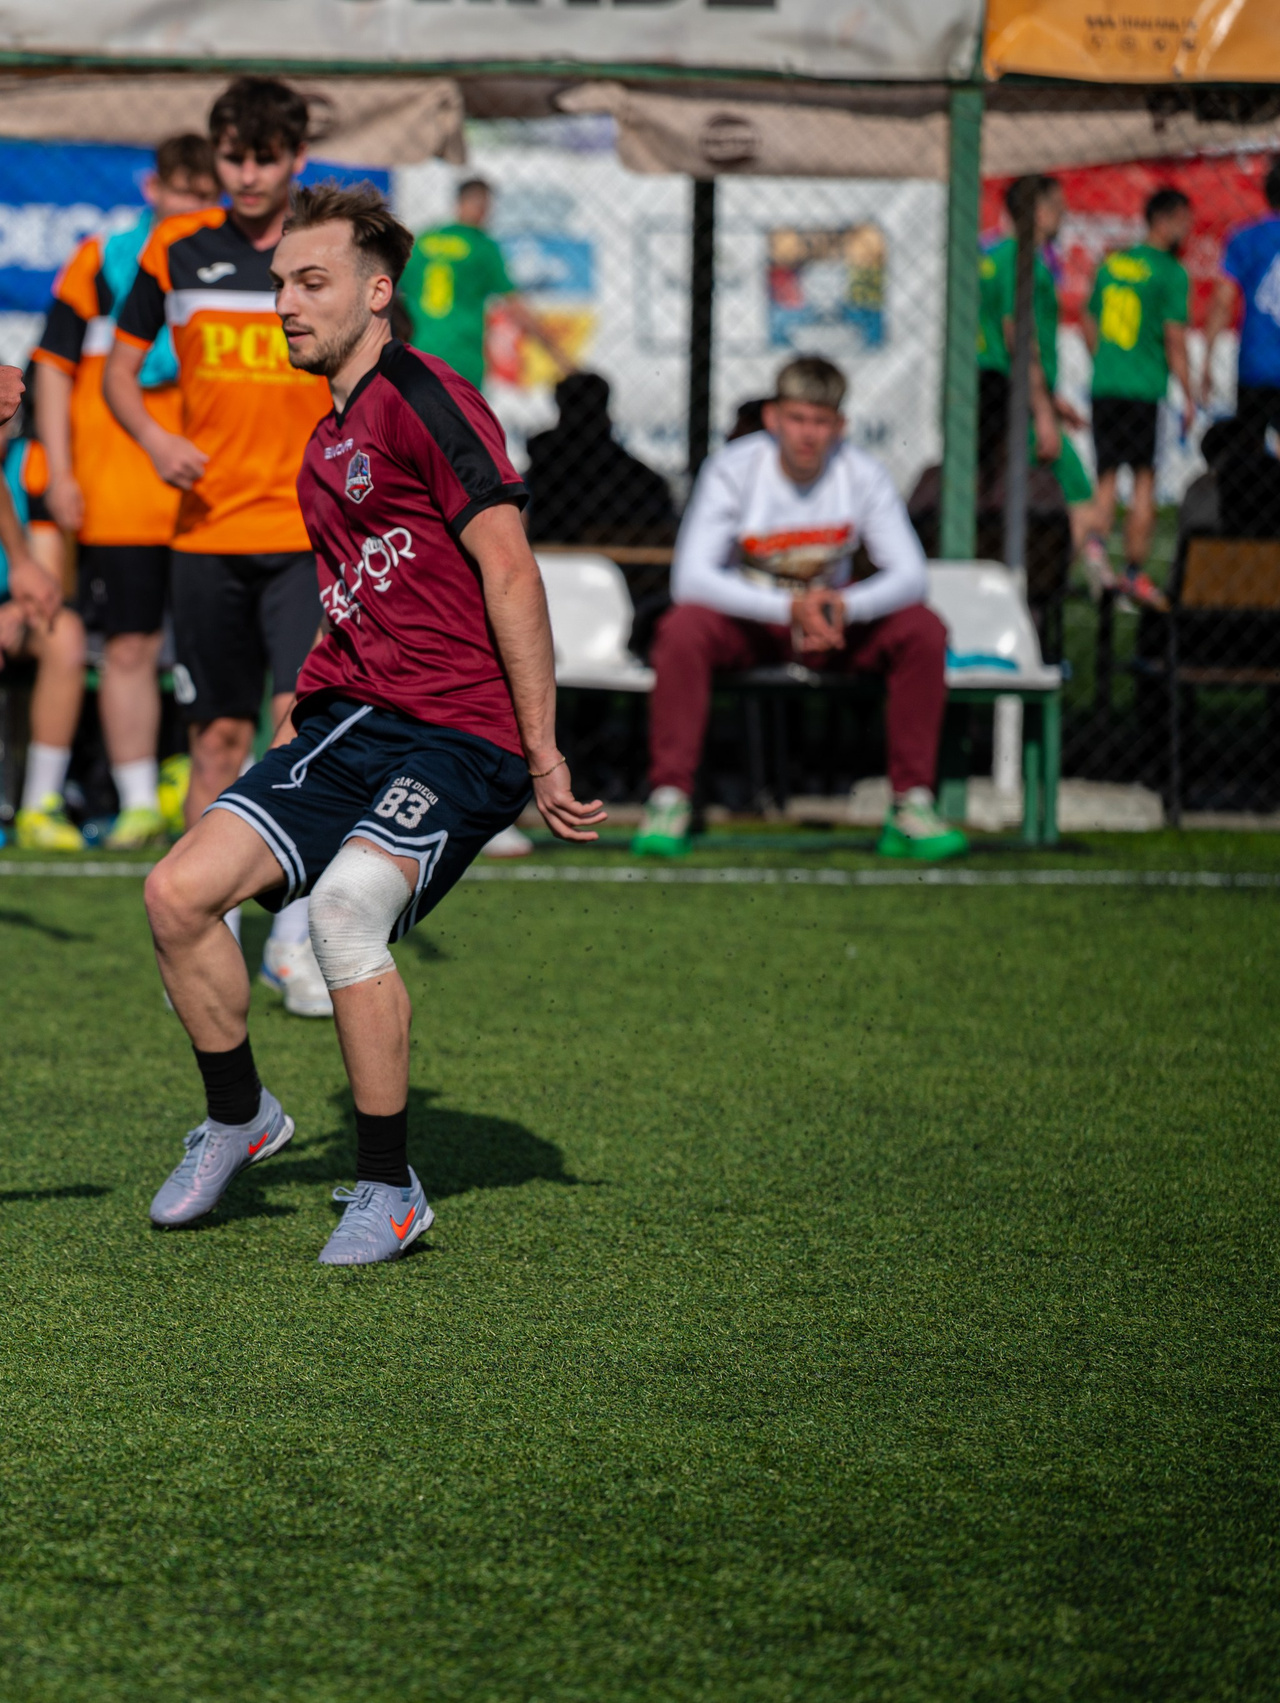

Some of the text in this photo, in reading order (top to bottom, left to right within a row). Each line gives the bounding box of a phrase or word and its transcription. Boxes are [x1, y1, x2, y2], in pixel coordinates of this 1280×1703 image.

[374, 787, 431, 830] 83
[391, 776, 439, 806] SAN DIEGO
